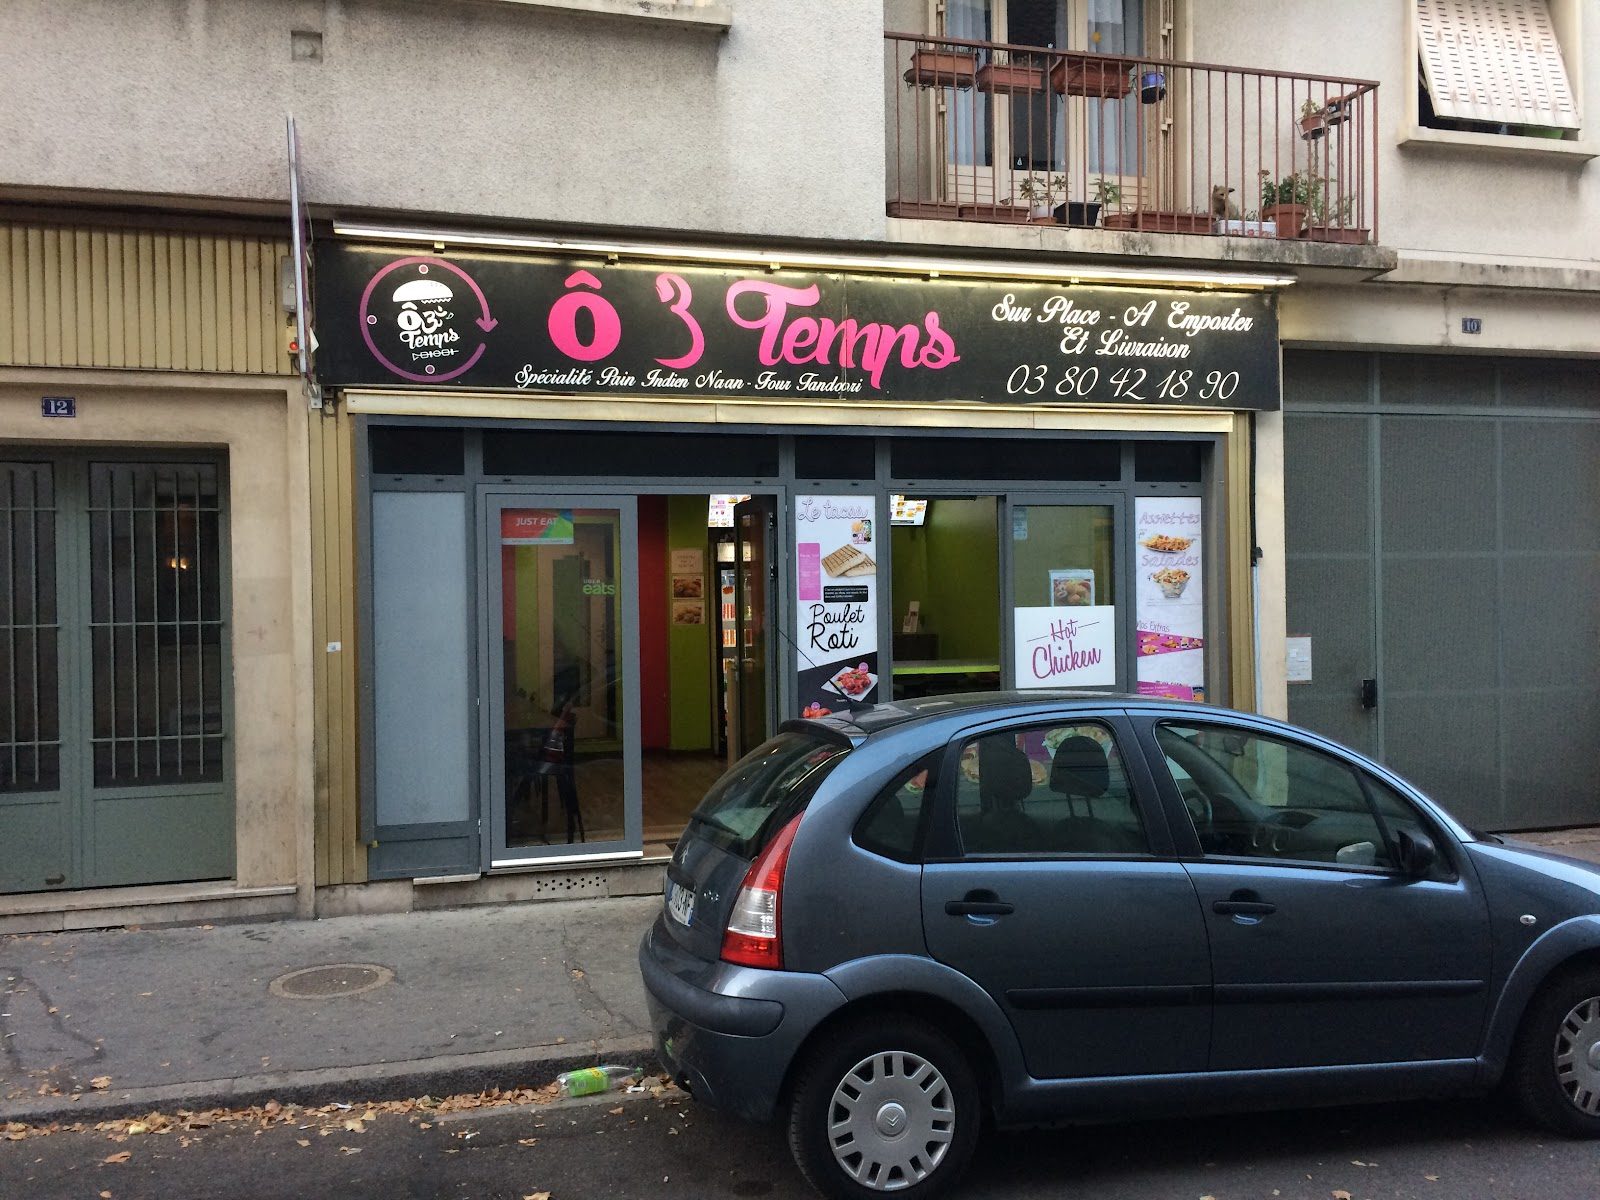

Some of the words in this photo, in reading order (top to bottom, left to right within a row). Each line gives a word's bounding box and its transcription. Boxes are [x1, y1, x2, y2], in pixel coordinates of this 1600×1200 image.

[992, 293, 1031, 323] Sur
[1037, 296, 1100, 326] Place
[1124, 300, 1157, 327] A
[1168, 301, 1253, 337] Emporter
[1466, 319, 1478, 332] 10
[399, 328, 460, 350] Temps
[548, 270, 621, 362] Ô
[654, 273, 705, 369] 3
[726, 279, 960, 389] Temps
[1060, 327, 1090, 355] Et
[1095, 329, 1190, 359] Livraison
[515, 364, 593, 389] Spécialité
[596, 367, 636, 387] Pain
[641, 369, 689, 389] Indien
[696, 370, 744, 391] Naan
[796, 372, 862, 393] Tandoori
[1006, 364, 1047, 395] 03
[1055, 366, 1099, 396] 80
[1109, 367, 1148, 400] 42
[1156, 369, 1193, 399] 18
[1199, 371, 1240, 400] 90
[49, 400, 68, 414] 12
[516, 517, 539, 527] JUST
[540, 518, 559, 528] EAT
[797, 497, 821, 523] Le
[583, 583, 615, 595] eats
[809, 603, 865, 624] Poulet
[807, 622, 859, 652] Roti
[1050, 618, 1078, 642] Hot
[1032, 640, 1101, 679] Chicken
